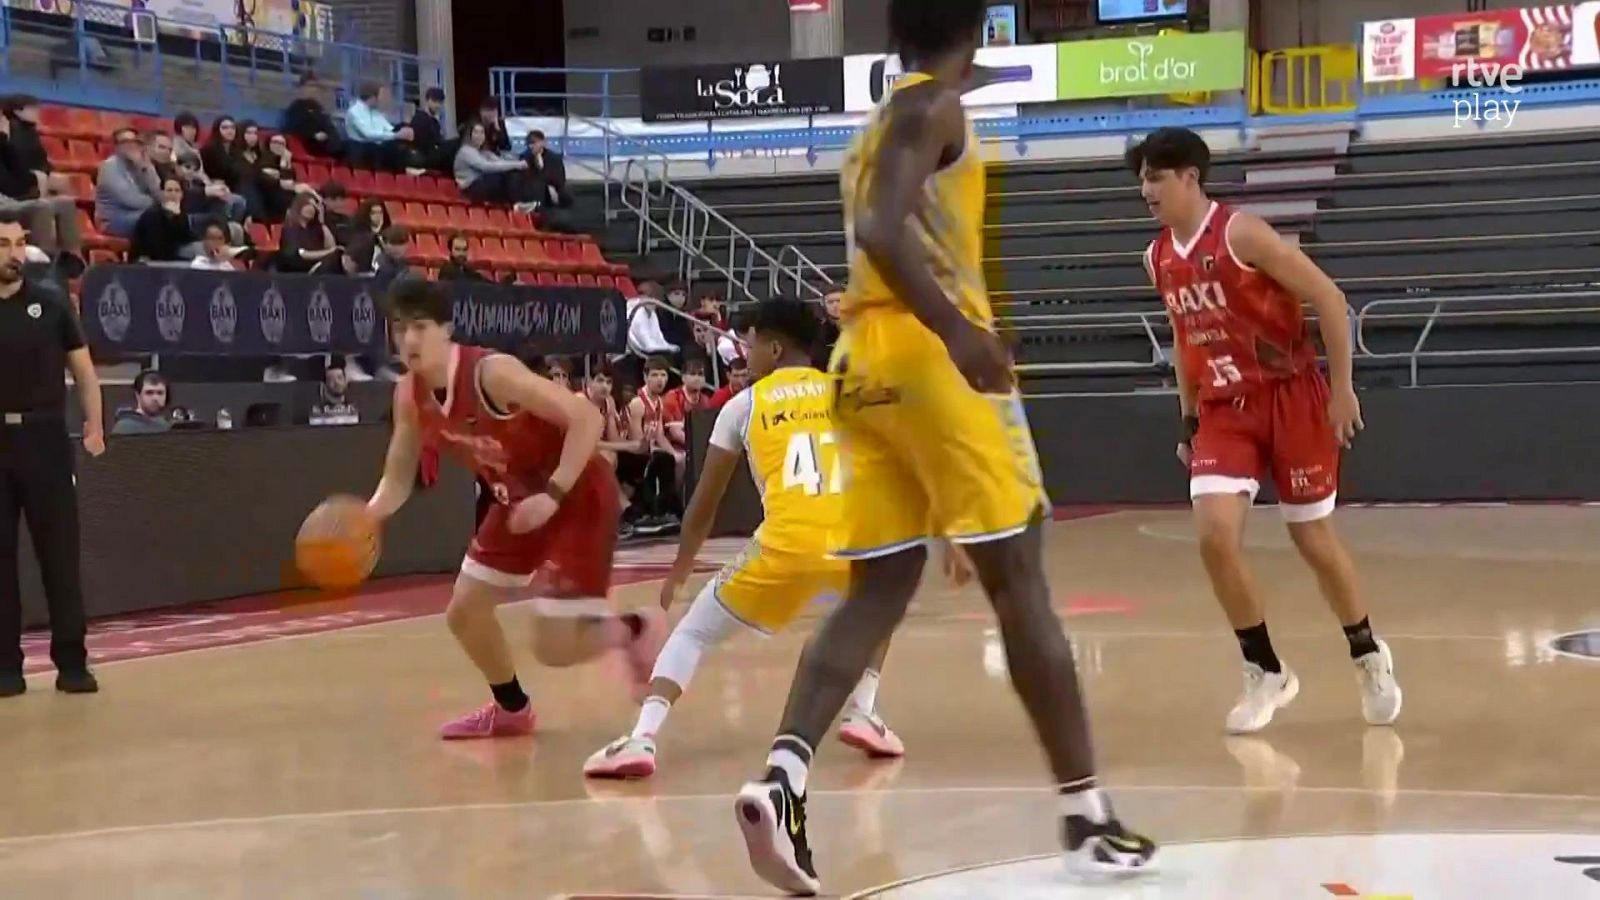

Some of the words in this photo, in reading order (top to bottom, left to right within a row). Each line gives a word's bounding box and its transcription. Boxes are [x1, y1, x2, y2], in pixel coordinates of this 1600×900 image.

[1100, 50, 1148, 83] brot
[1154, 58, 1197, 81] d'or
[697, 79, 713, 96] la
[714, 79, 786, 109] Soca
[157, 302, 185, 318] BAXI
[211, 303, 237, 320] BAXI
[1165, 280, 1227, 314] BAXI
[1206, 355, 1242, 387] 15
[782, 431, 842, 497] 47
